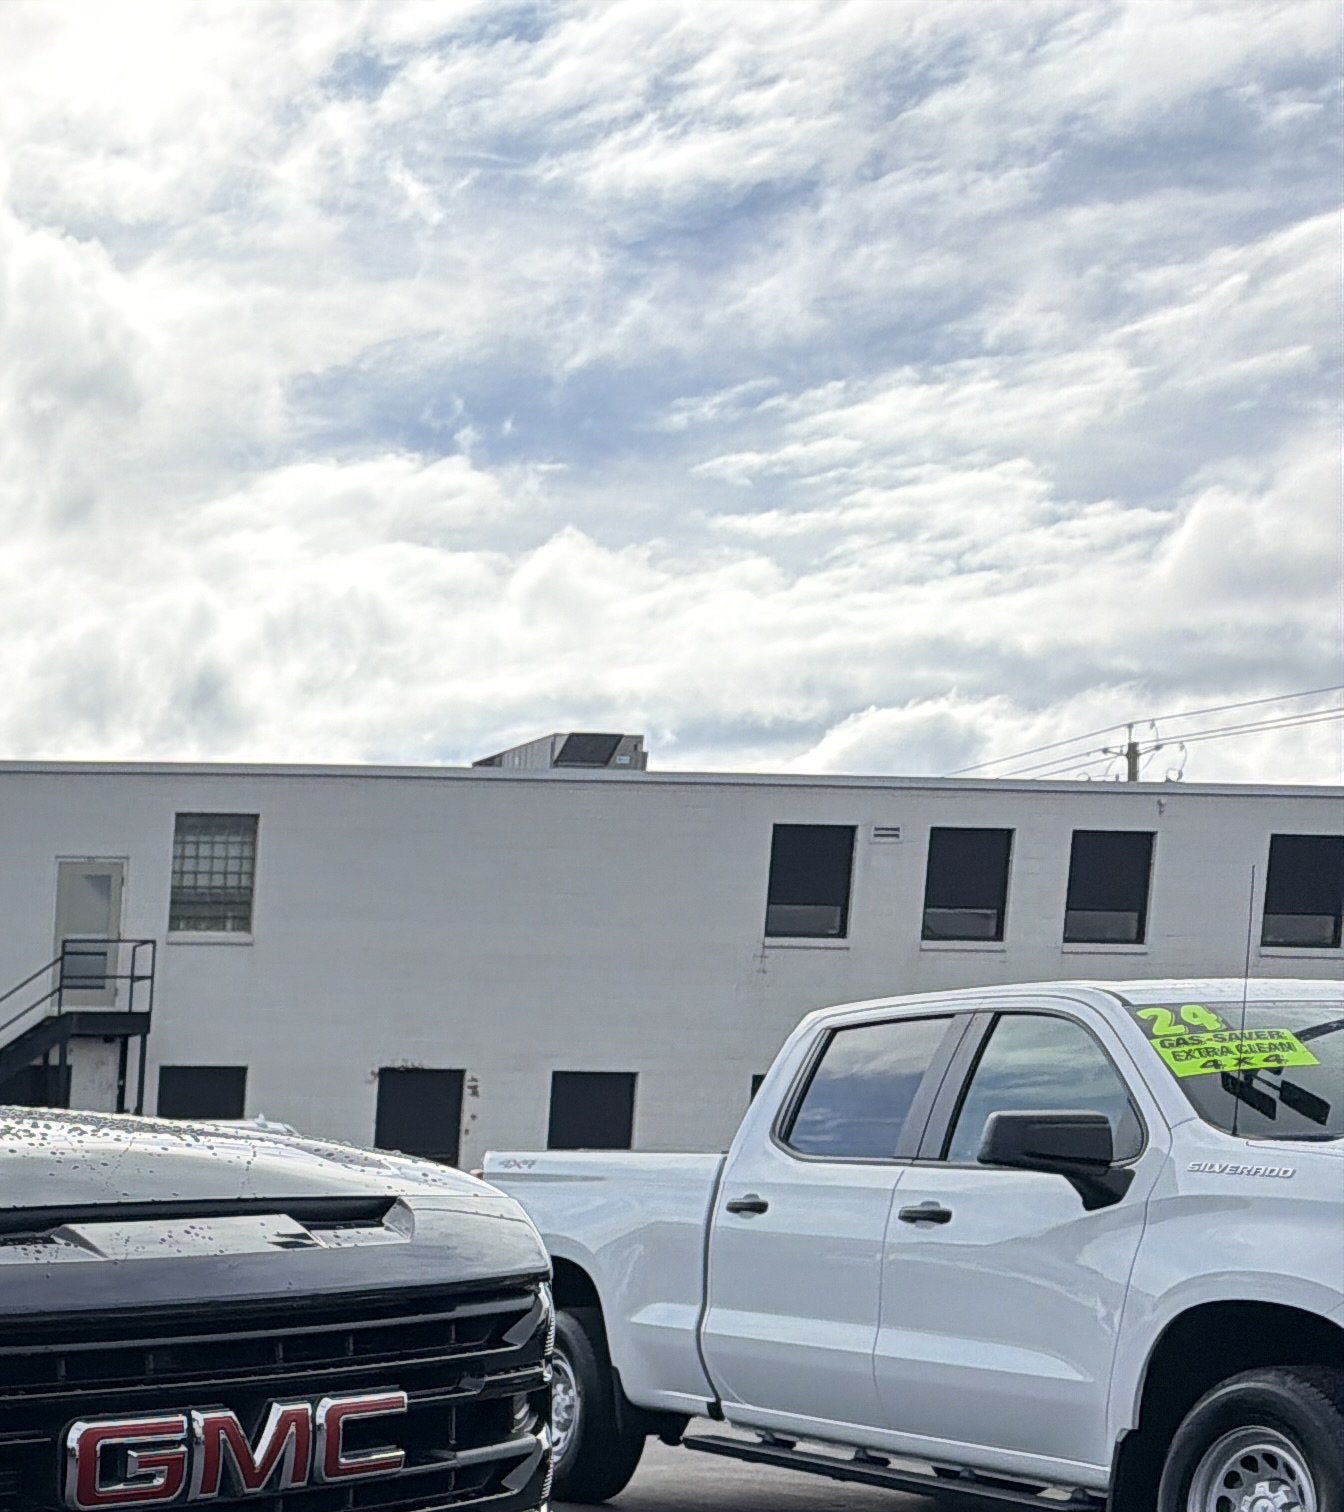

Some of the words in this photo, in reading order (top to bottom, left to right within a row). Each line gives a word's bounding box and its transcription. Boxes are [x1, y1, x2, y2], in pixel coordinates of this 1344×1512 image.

[1136, 1005, 1226, 1035] 24
[1171, 1045, 1237, 1062] EXTRA
[1235, 1041, 1297, 1055] CLEAN
[1187, 1162, 1296, 1178] SILVERADO
[65, 1390, 408, 1511] GMC
